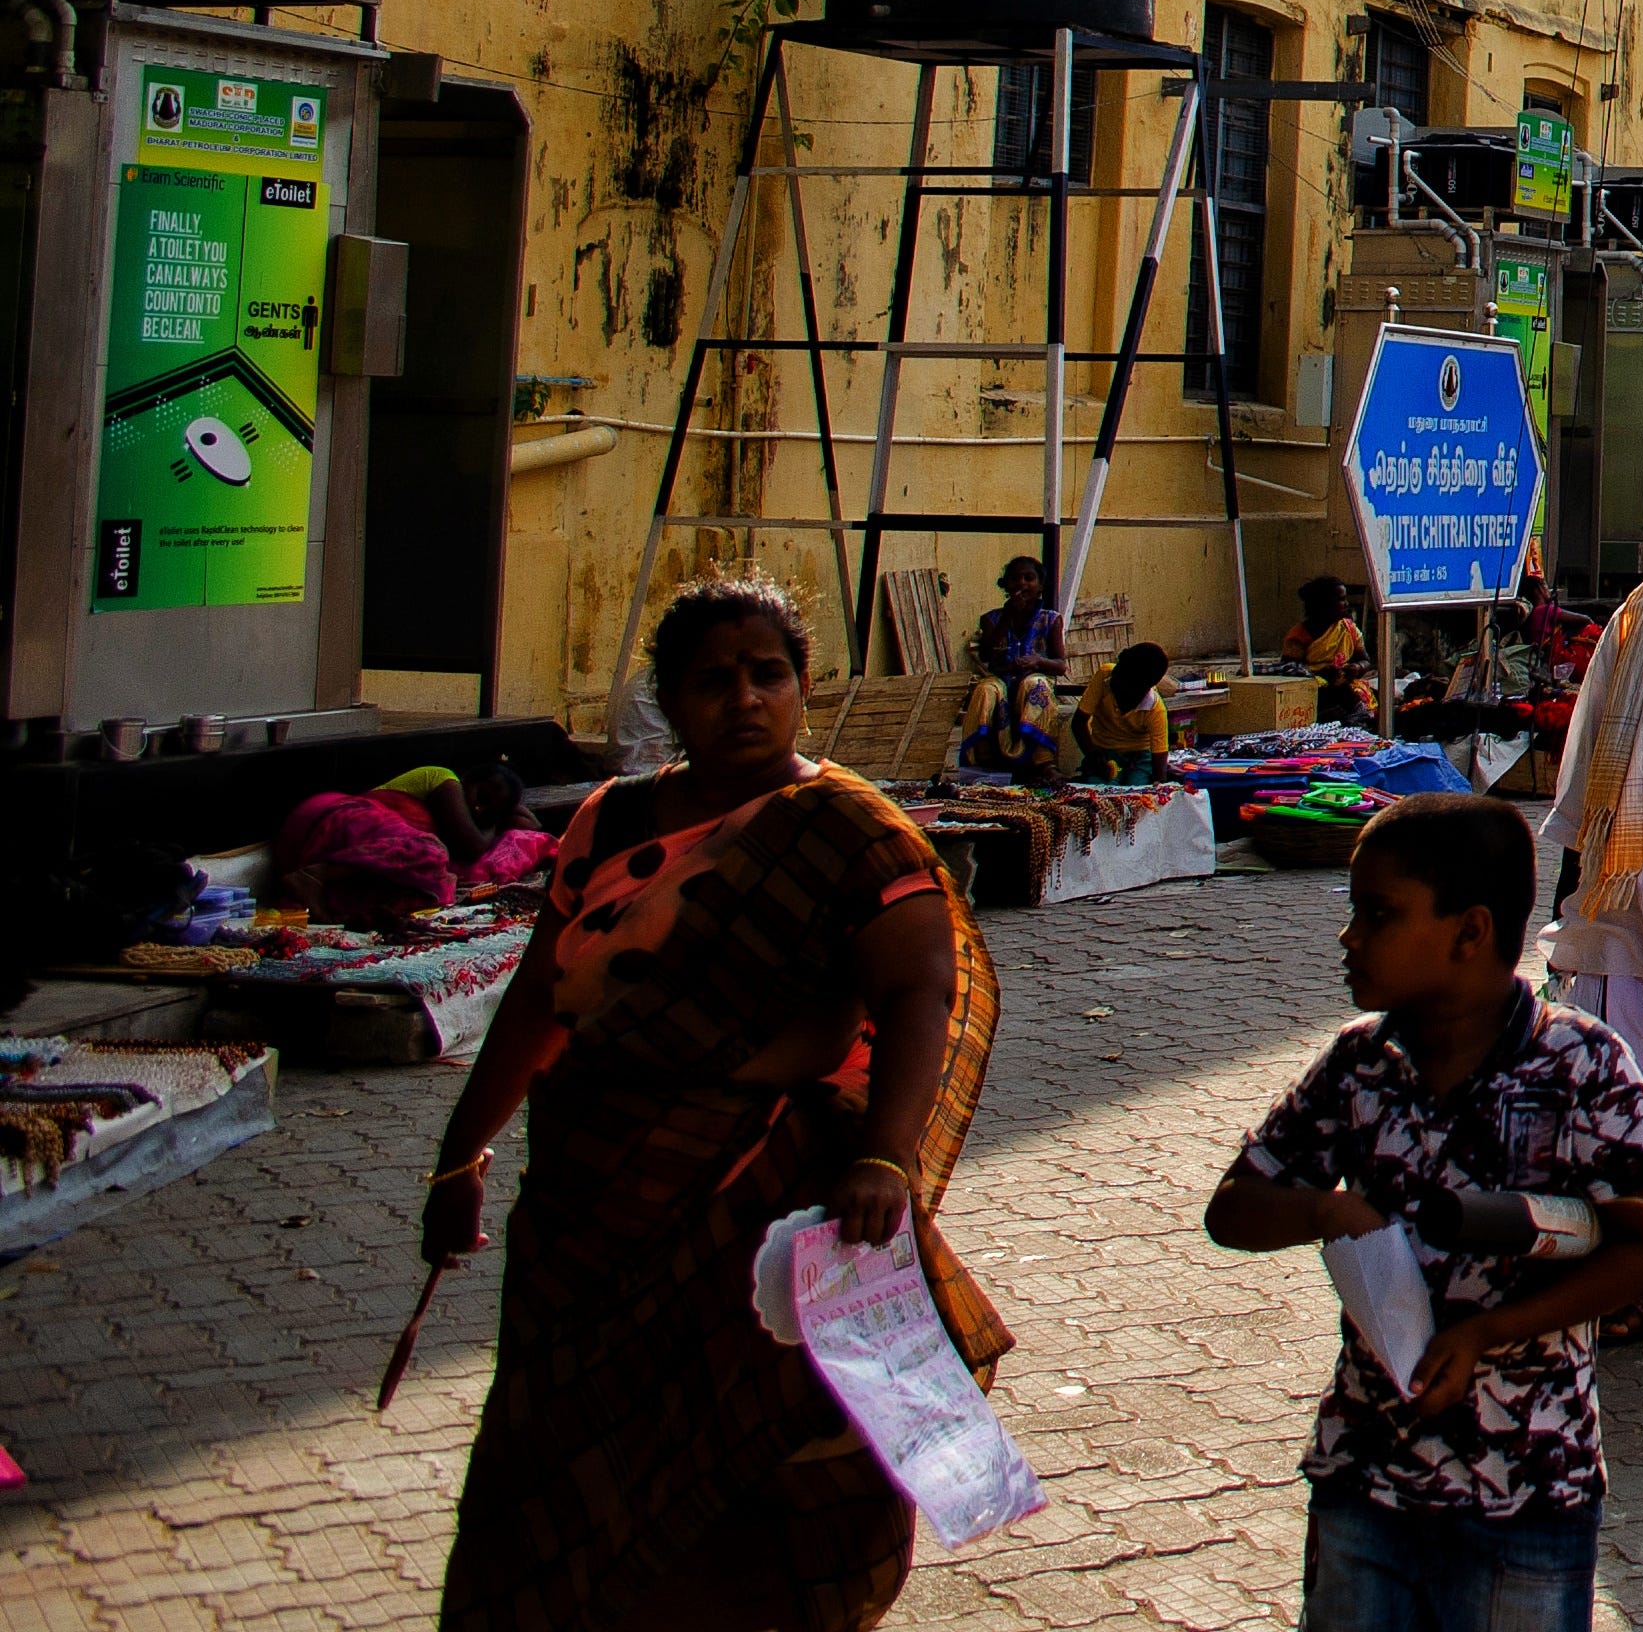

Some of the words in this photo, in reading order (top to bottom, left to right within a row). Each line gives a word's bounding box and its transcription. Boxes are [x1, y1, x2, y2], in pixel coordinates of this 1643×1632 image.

[188, 118, 227, 131] MADURAI
[228, 122, 284, 137] CORPORATION
[146, 136, 180, 147] BHARAT
[182, 140, 232, 152] PETROLEUM
[233, 146, 287, 159] CORPORATION
[289, 151, 318, 163] LIMITED
[142, 168, 171, 186] Eram
[174, 171, 225, 193] Scientific
[265, 180, 311, 204] eToilet
[150, 209, 203, 235] FINALLY,
[149, 238, 157, 258] A
[160, 238, 202, 260] TOILET
[203, 242, 227, 262] YOU
[146, 263, 173, 285] CAN
[174, 265, 228, 289] ALWAYS
[145, 290, 186, 312] COUNT
[187, 293, 205, 314] ON
[206, 294, 220, 315] TO
[248, 301, 300, 319] GENTS
[143, 317, 158, 338] BE
[160, 317, 204, 340] CLEAN.
[1408, 416, 1438, 434] மதுரை
[1440, 415, 1488, 434] மாநகராட்சி
[1374, 440, 1422, 498] தெற்கு
[1427, 442, 1488, 498] சித்திரை
[1492, 441, 1518, 496] வீதி
[240, 525, 277, 534] technology
[287, 524, 304, 532] clean
[1421, 515, 1471, 550] CHITRAI
[1473, 515, 1518, 549] STREET
[211, 538, 230, 547] every
[110, 526, 132, 591] eToilet
